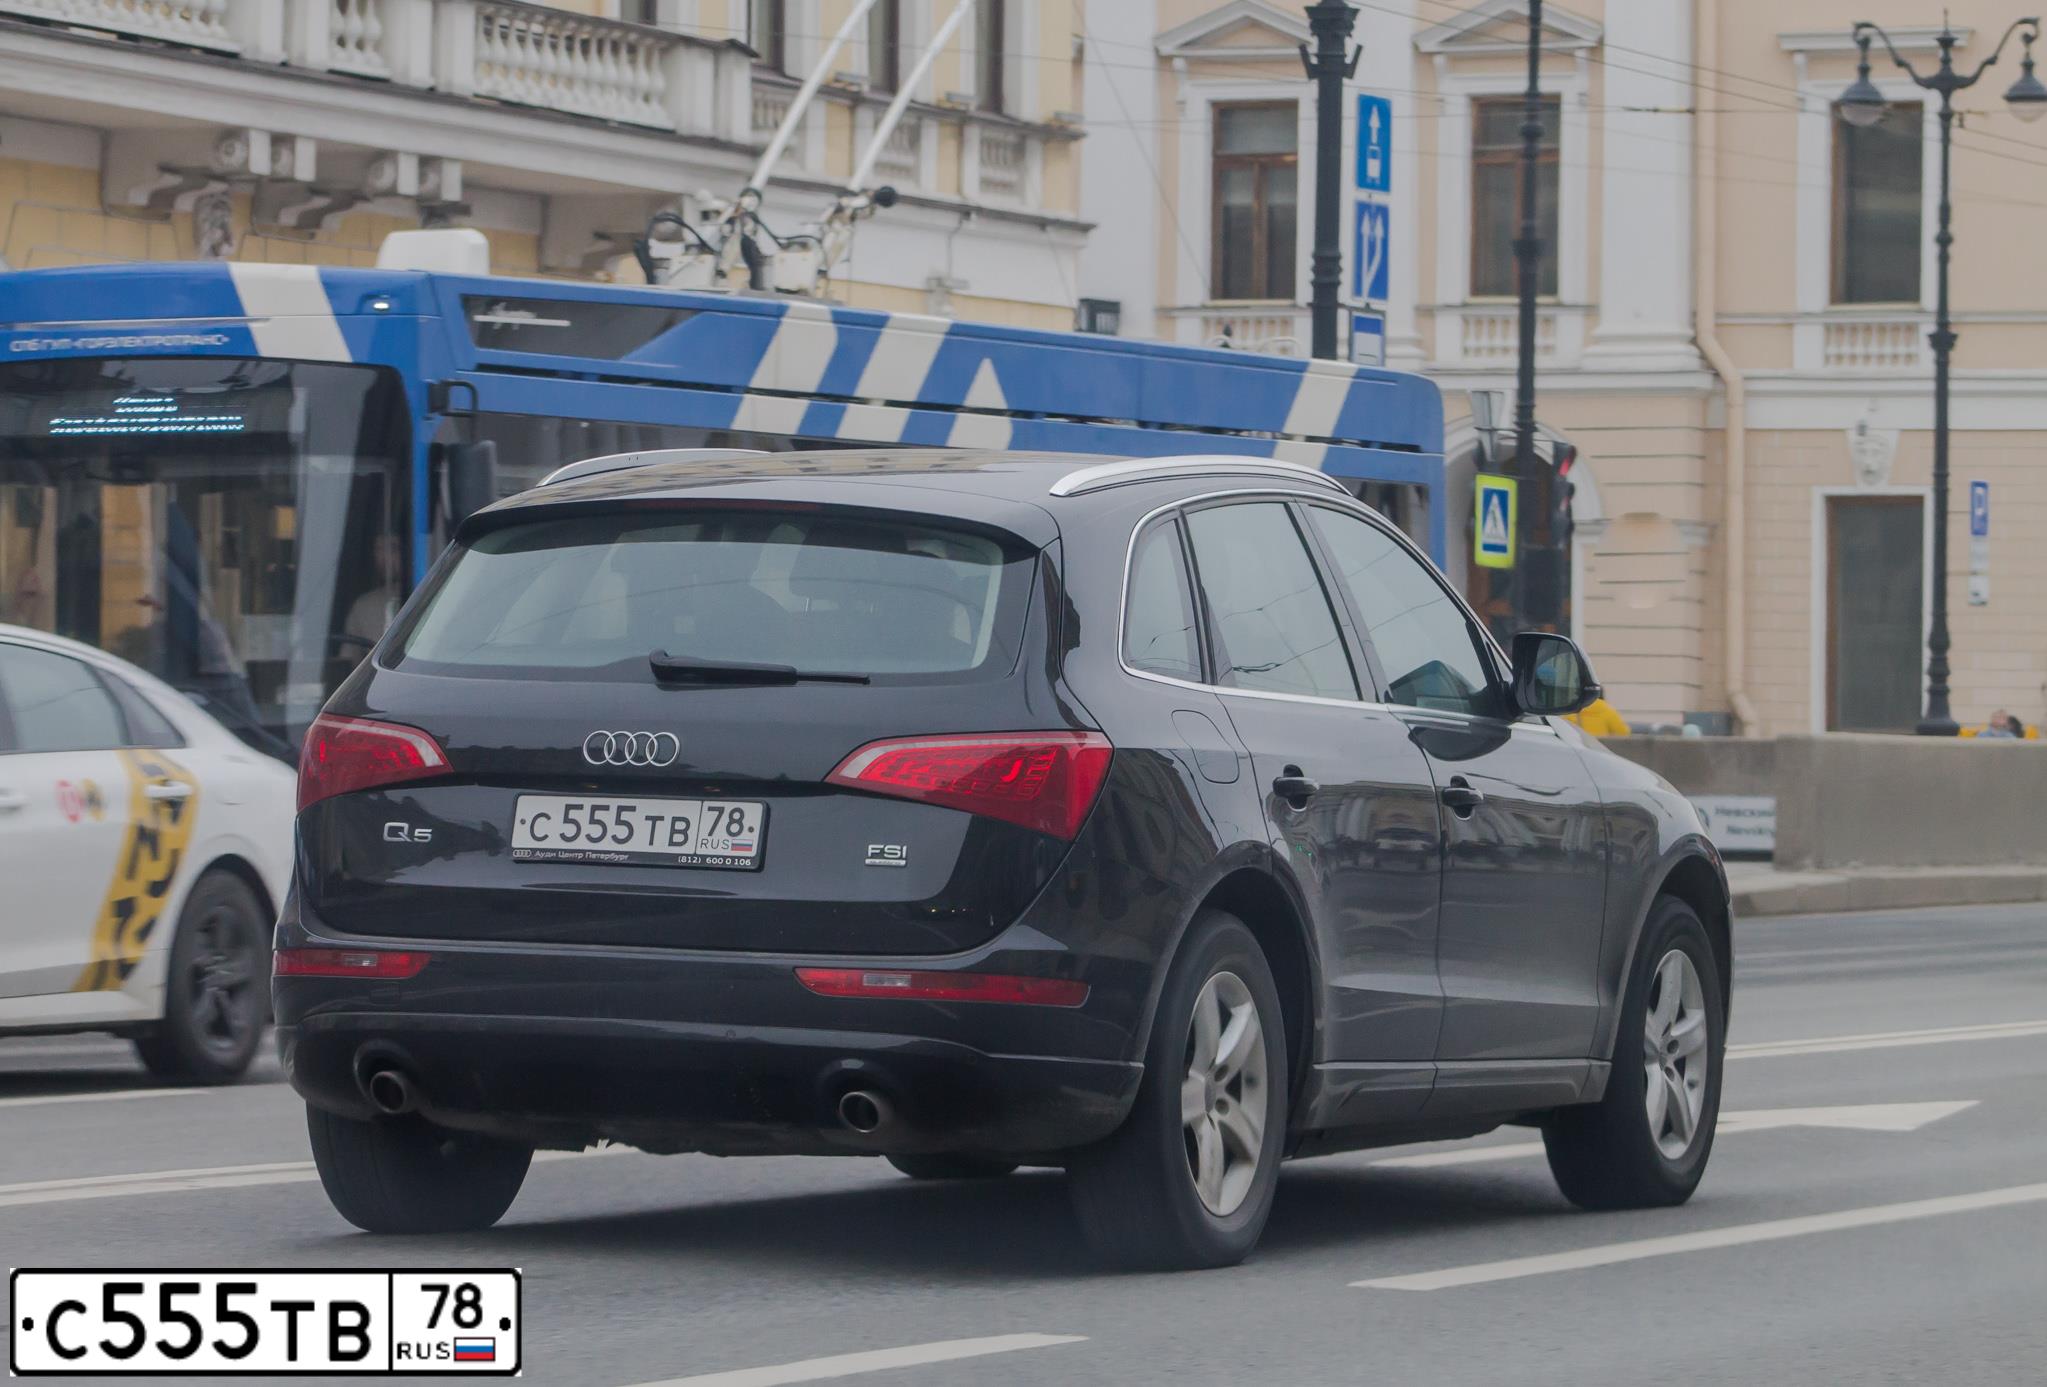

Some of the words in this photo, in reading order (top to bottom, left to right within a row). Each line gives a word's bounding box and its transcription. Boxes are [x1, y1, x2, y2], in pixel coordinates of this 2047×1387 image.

[706, 806, 744, 838] 78
[384, 821, 433, 843] Q5
[700, 838, 730, 850] RUS
[534, 850, 556, 859] Ауди
[558, 850, 584, 860] Центр
[585, 851, 629, 861] Петербург
[867, 844, 907, 859] FSI
[678, 855, 701, 864] (812)
[706, 857, 723, 865] 600
[734, 858, 751, 866] 106
